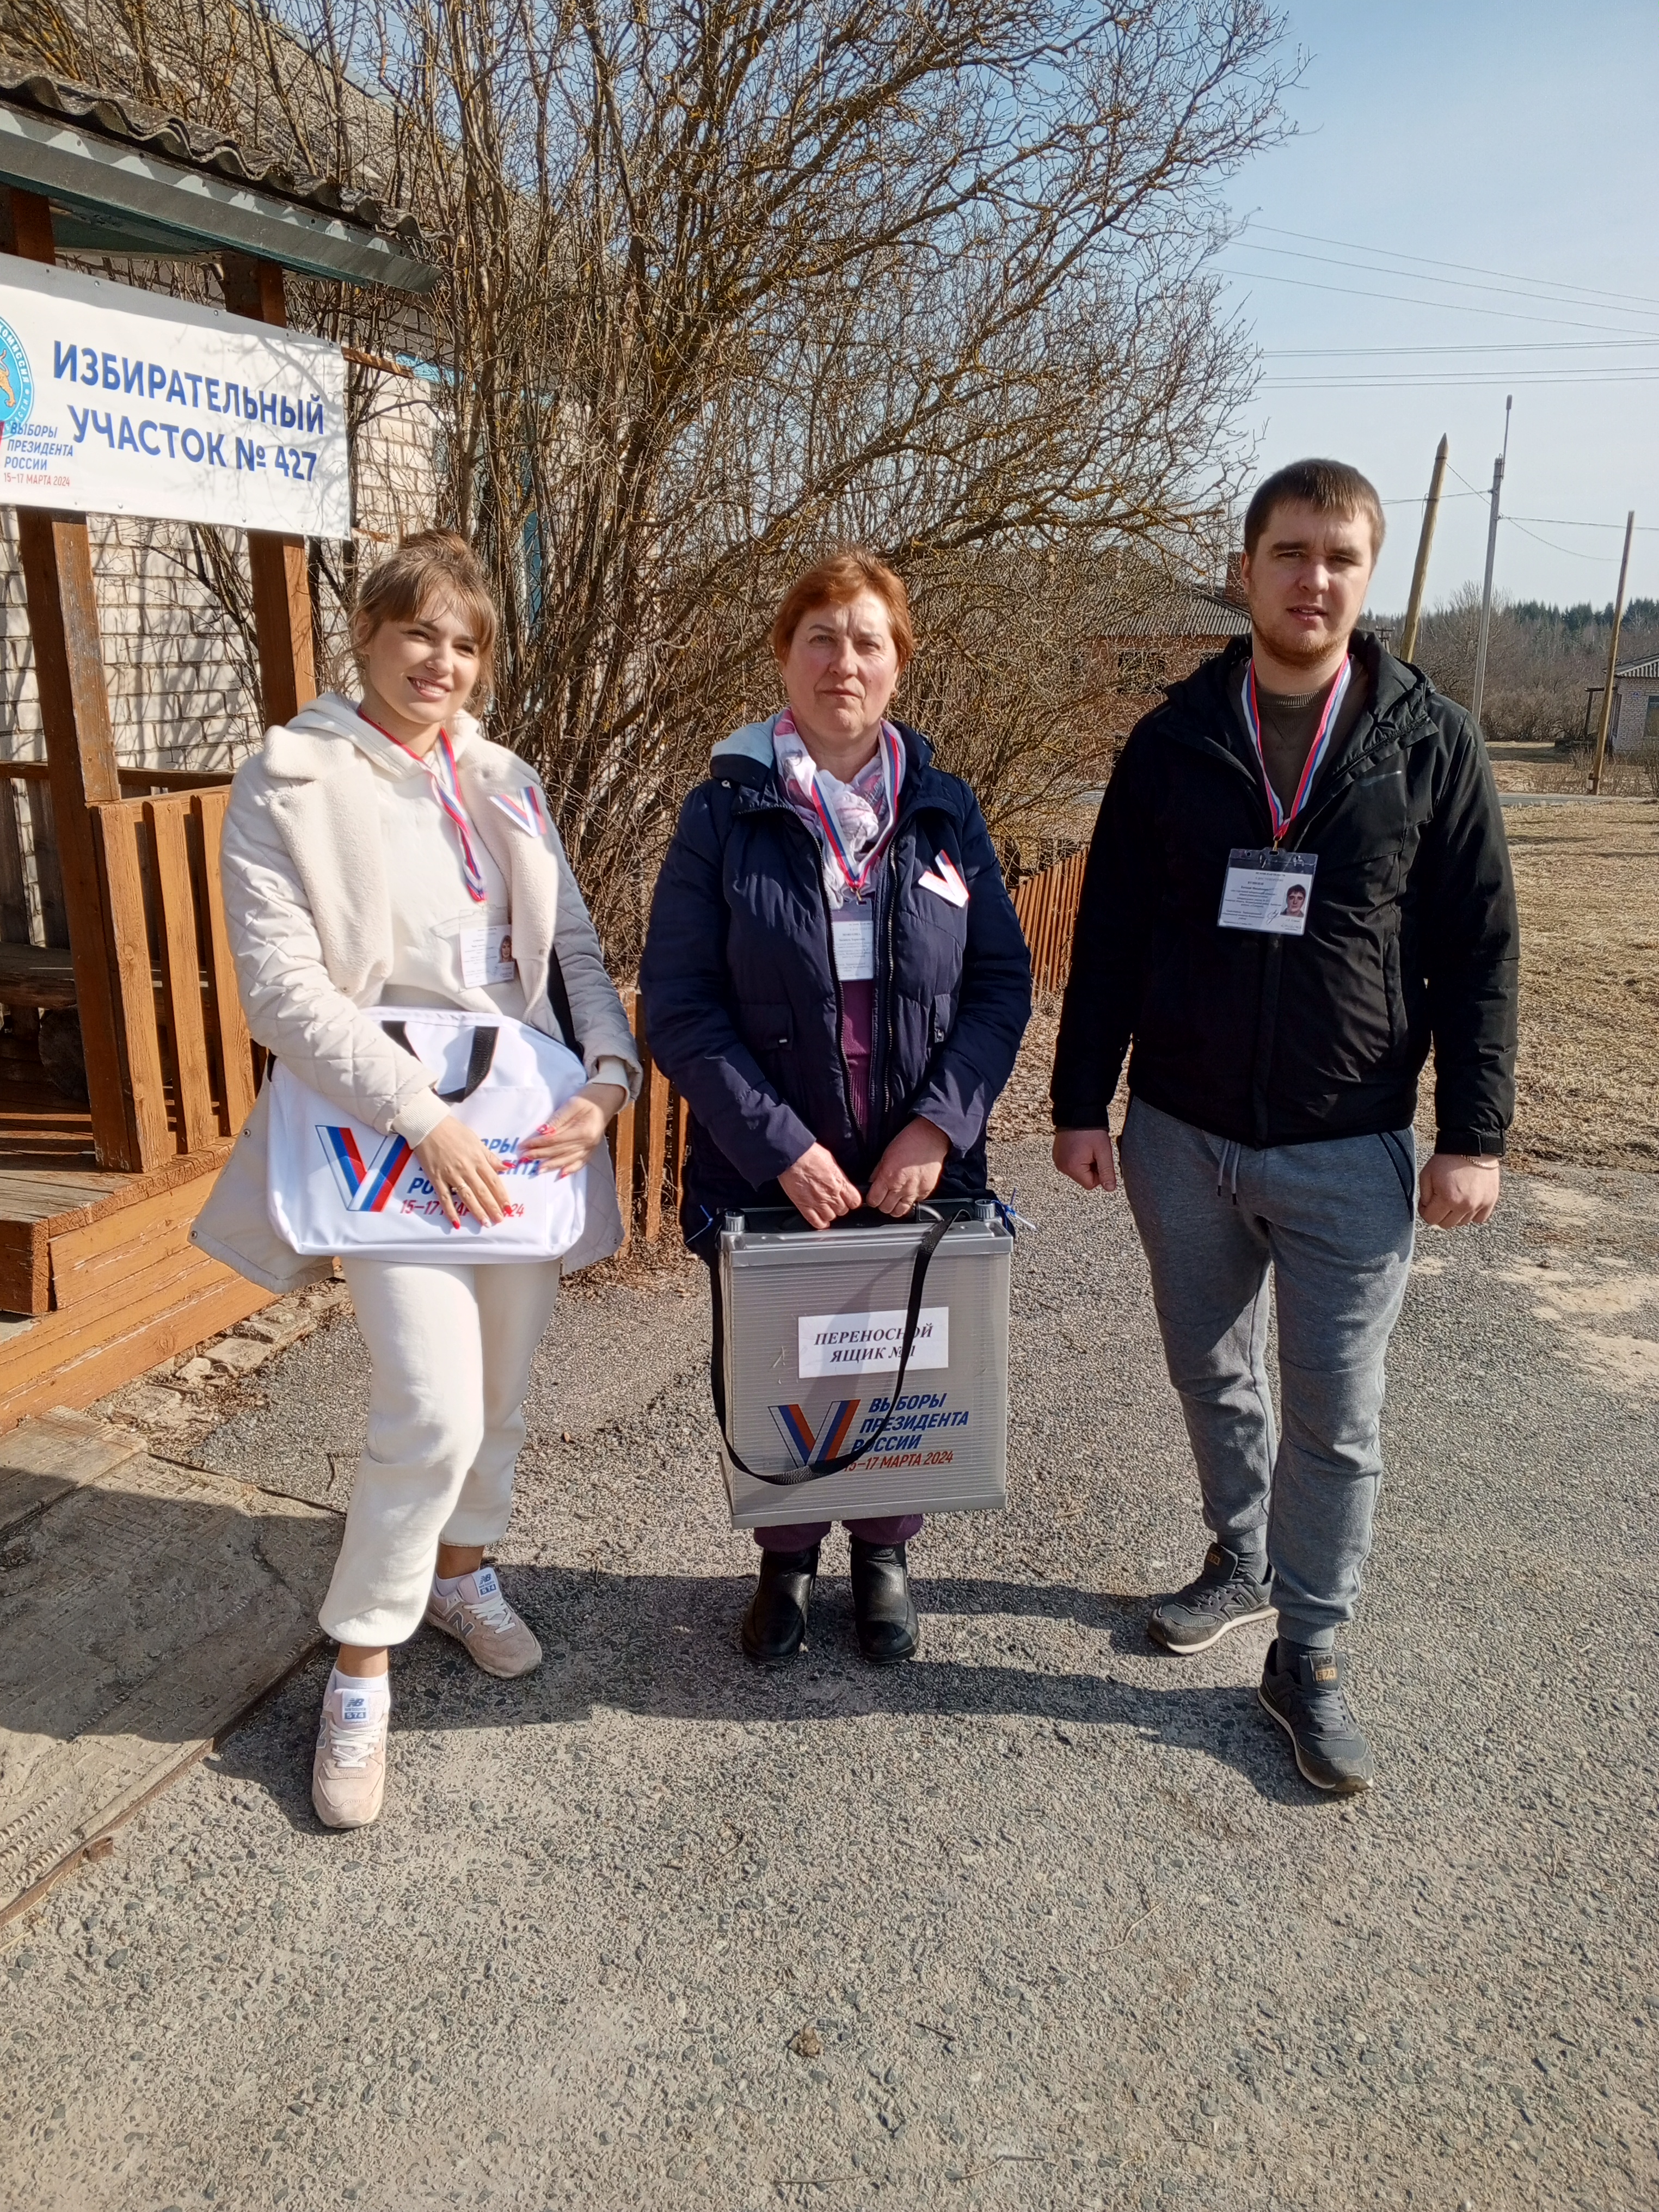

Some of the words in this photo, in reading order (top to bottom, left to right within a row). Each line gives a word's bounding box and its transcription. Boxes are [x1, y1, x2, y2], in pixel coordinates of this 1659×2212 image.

[0, 326, 29, 383] ОМИССИЯ
[54, 340, 324, 434] ИЗБИРАТЕЛЬНЫЙ
[10, 422, 58, 438] ВЫБОРЫ
[7, 439, 73, 457] ПРЕЗИДЕНТА
[66, 404, 226, 468] УЧАСТОК
[236, 439, 266, 471] №
[274, 445, 317, 482] 427
[4, 456, 47, 470] РОССИИ
[26, 474, 51, 486] МАРТА
[53, 476, 70, 487] 2024
[830, 1347, 886, 1363] ЯЩИК
[859, 1411, 969, 1434] ПРЕЗИДЕНТА
[880, 1453, 922, 1468] МАРТА
[923, 1451, 954, 1465] 2024
[482, 1584, 495, 1594] 574
[1317, 1669, 1334, 1681] 574
